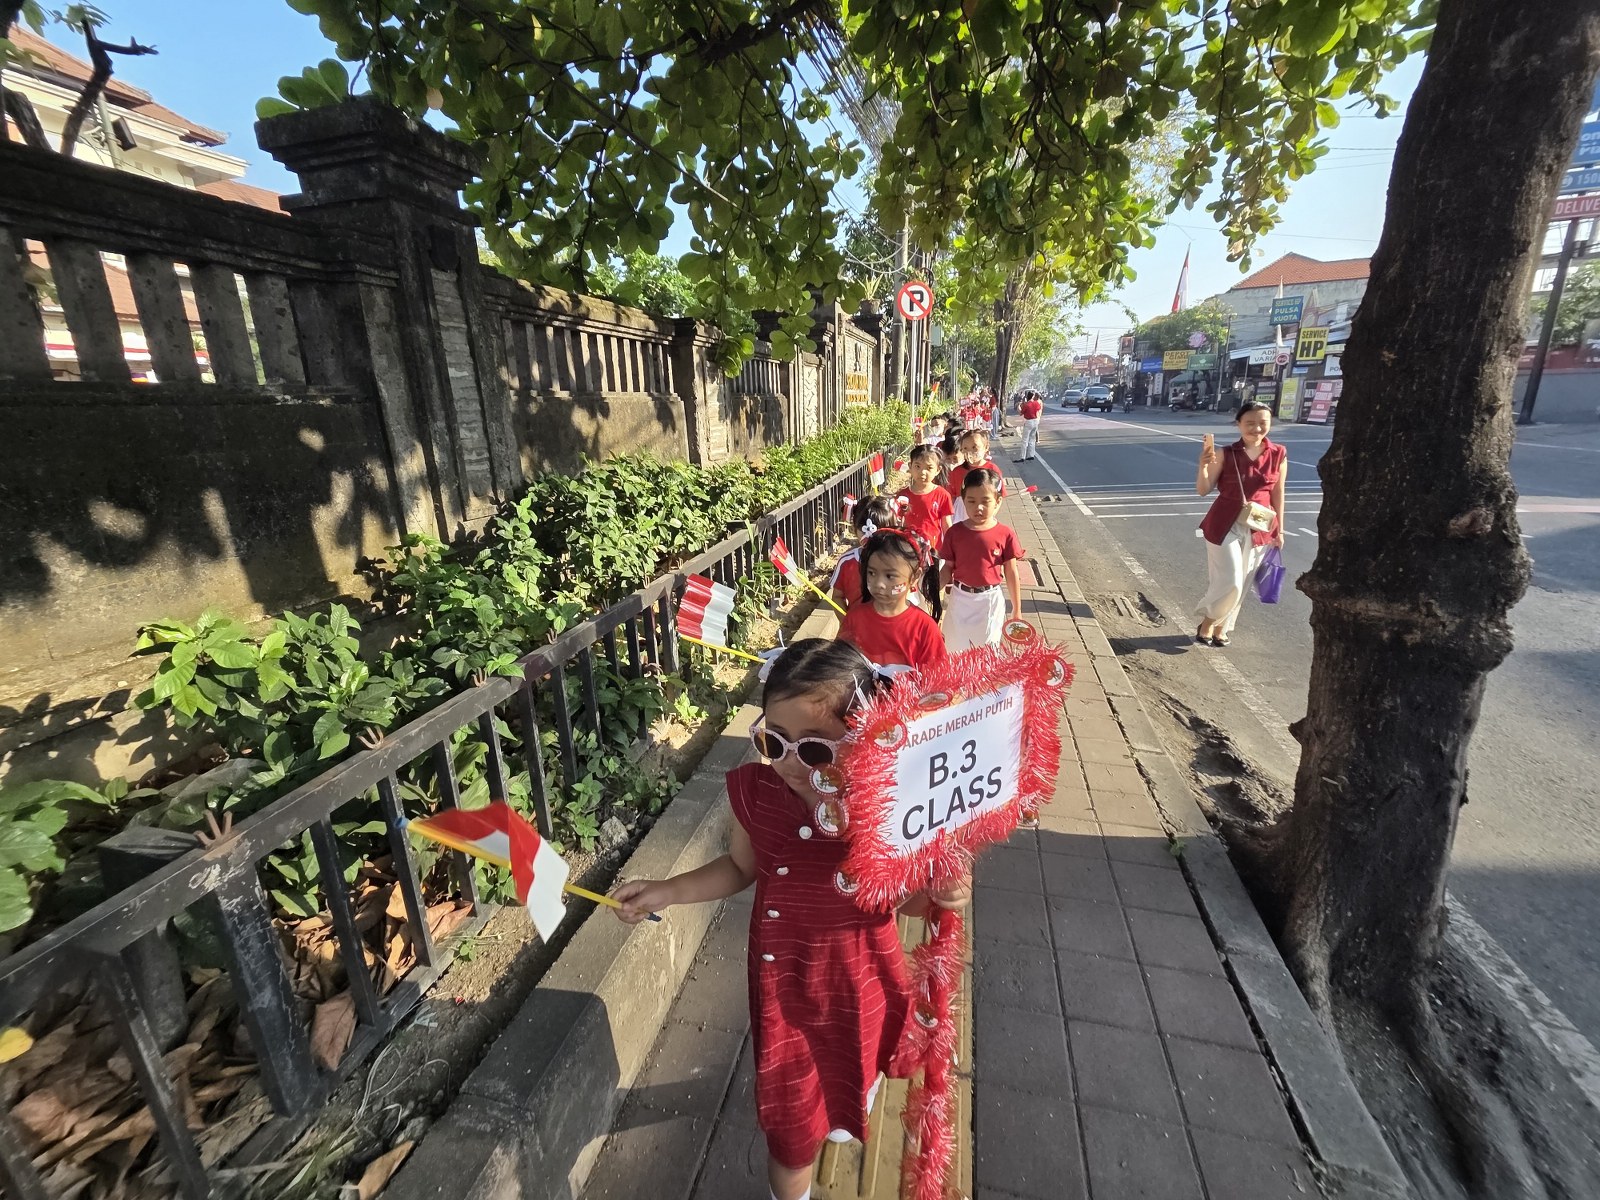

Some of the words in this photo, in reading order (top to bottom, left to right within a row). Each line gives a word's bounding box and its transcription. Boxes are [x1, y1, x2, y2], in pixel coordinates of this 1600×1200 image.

[1273, 314, 1298, 322] KUOTA
[1274, 306, 1299, 315] PULSA
[1302, 329, 1327, 339] SERVICE
[1299, 340, 1325, 358] HP
[902, 724, 943, 751] ARADE
[945, 709, 983, 734] MERAH
[985, 697, 1013, 718] PUTIH
[929, 739, 977, 790] B.3
[901, 766, 1002, 841] CLASS
